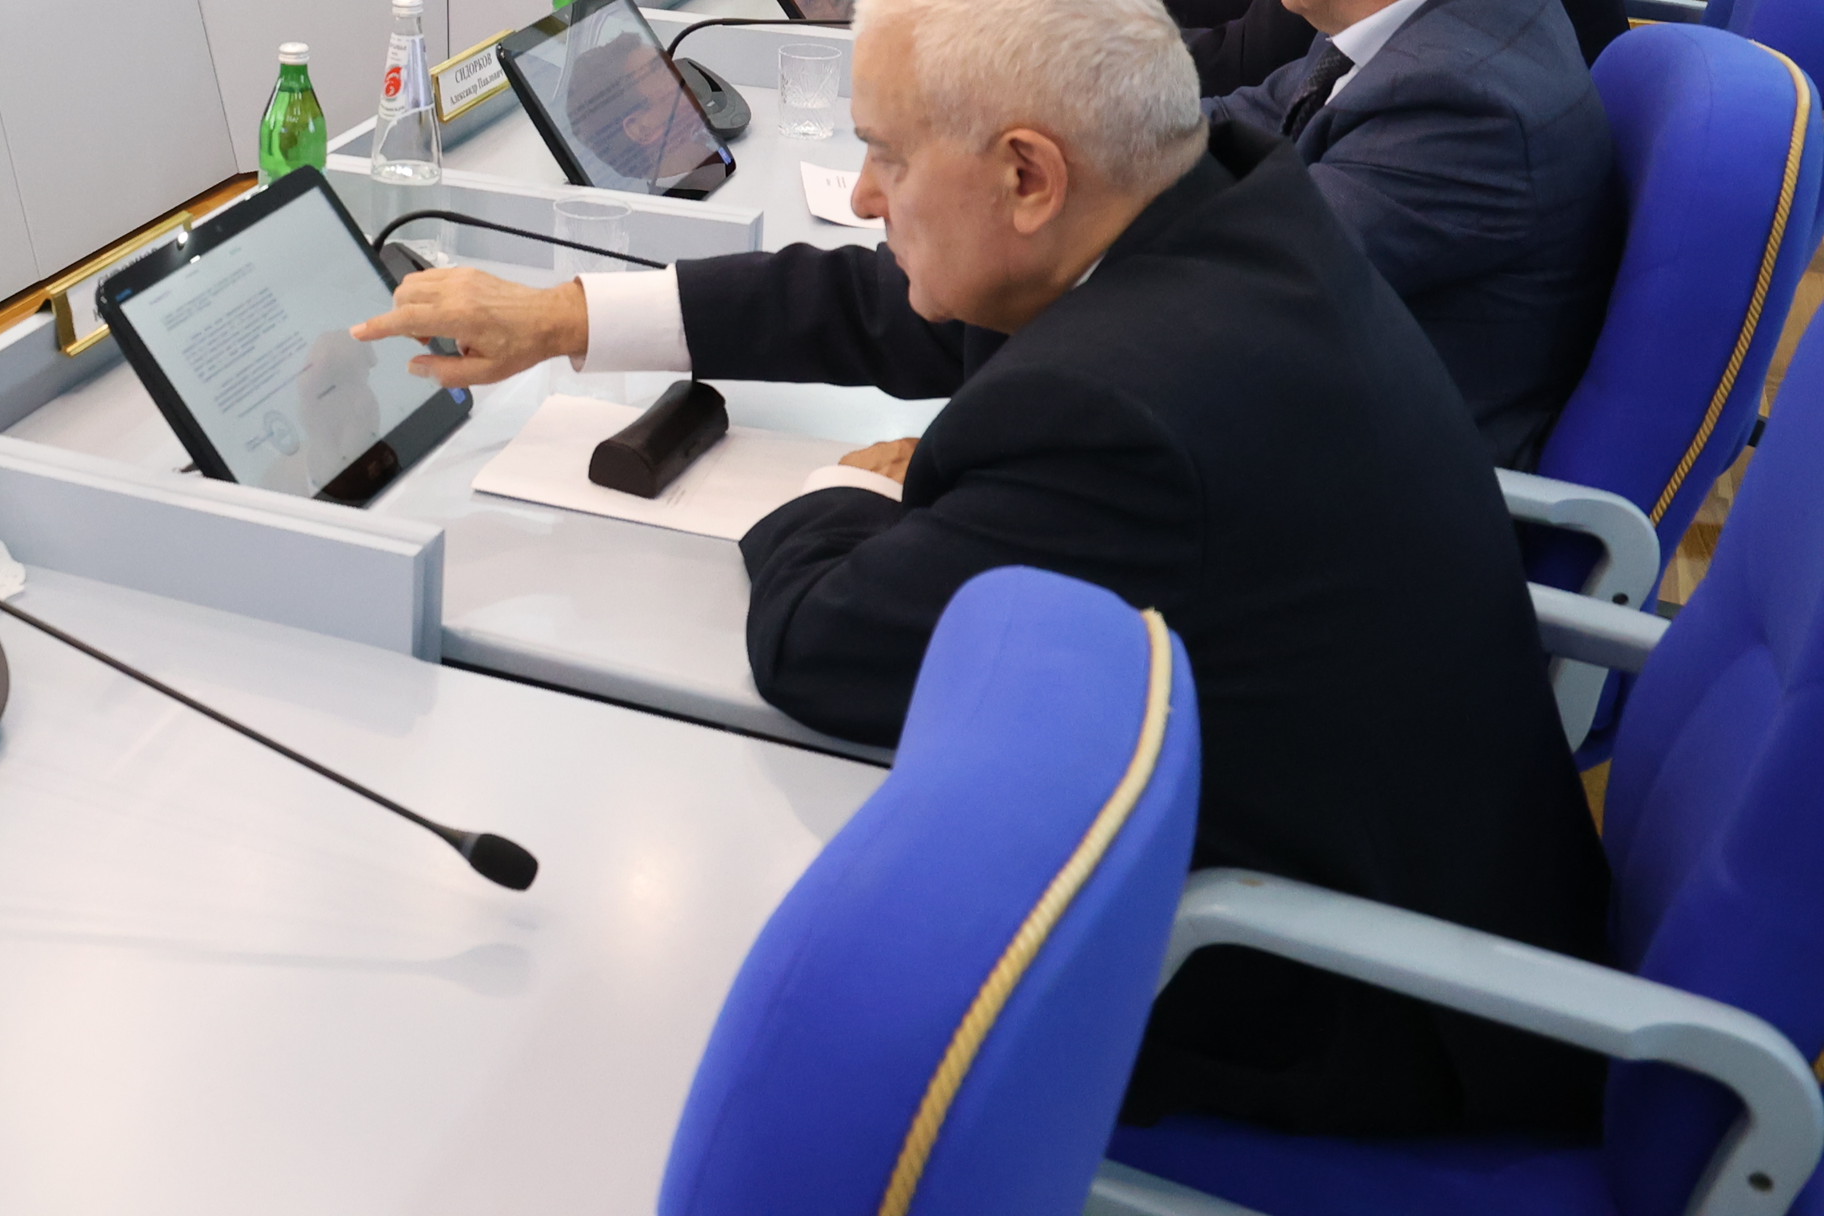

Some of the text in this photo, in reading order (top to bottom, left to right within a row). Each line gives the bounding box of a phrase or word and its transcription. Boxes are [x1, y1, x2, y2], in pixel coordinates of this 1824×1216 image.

[455, 52, 493, 84] СИДОРКОВ
[450, 68, 504, 105] Александр Павлович
